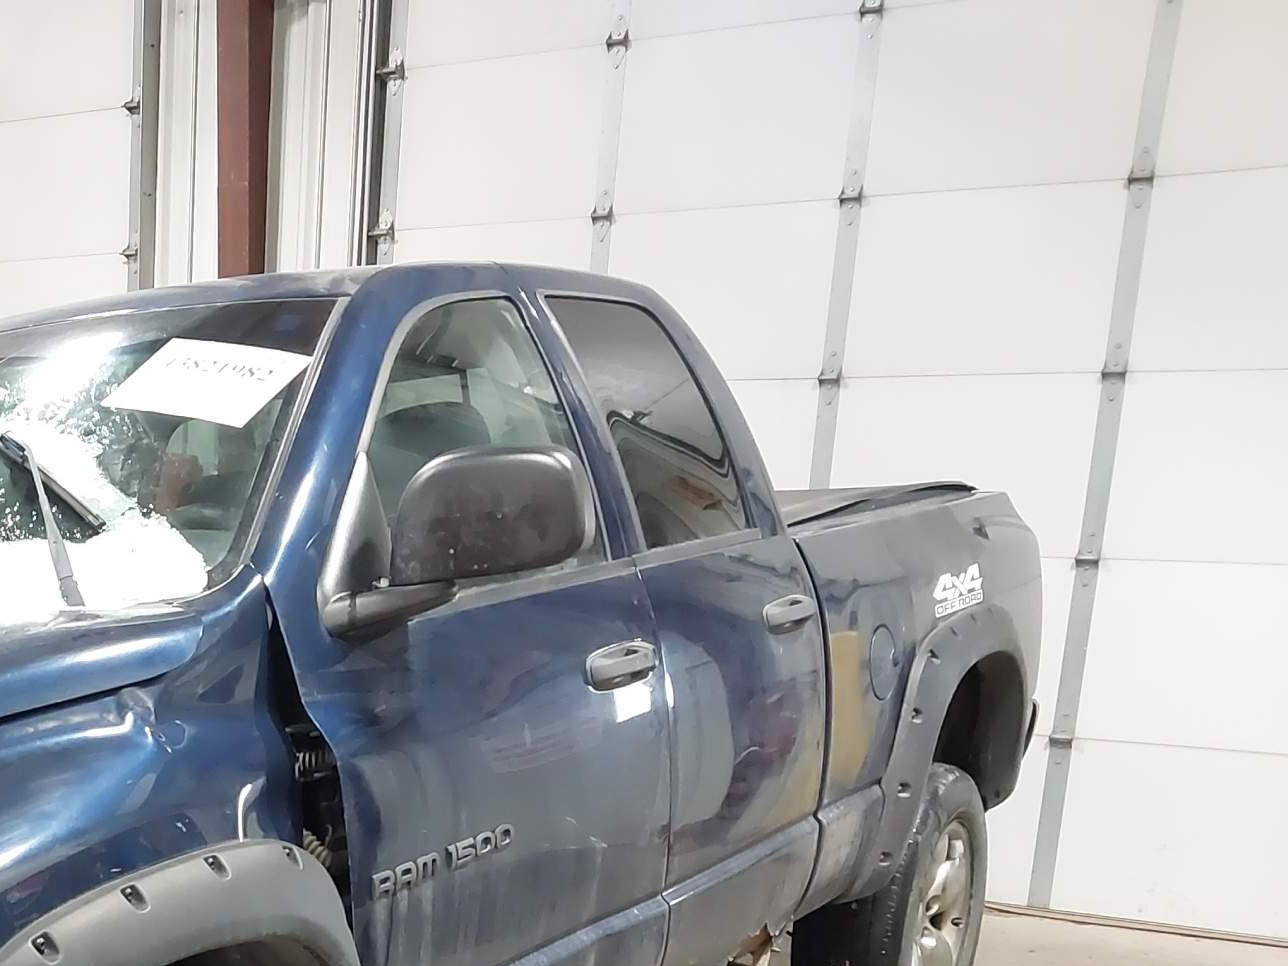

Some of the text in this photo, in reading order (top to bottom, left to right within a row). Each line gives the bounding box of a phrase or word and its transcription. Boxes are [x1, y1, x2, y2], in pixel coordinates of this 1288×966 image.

[936, 591, 982, 615] OFF ROAD
[372, 823, 514, 899] RAM 1500
